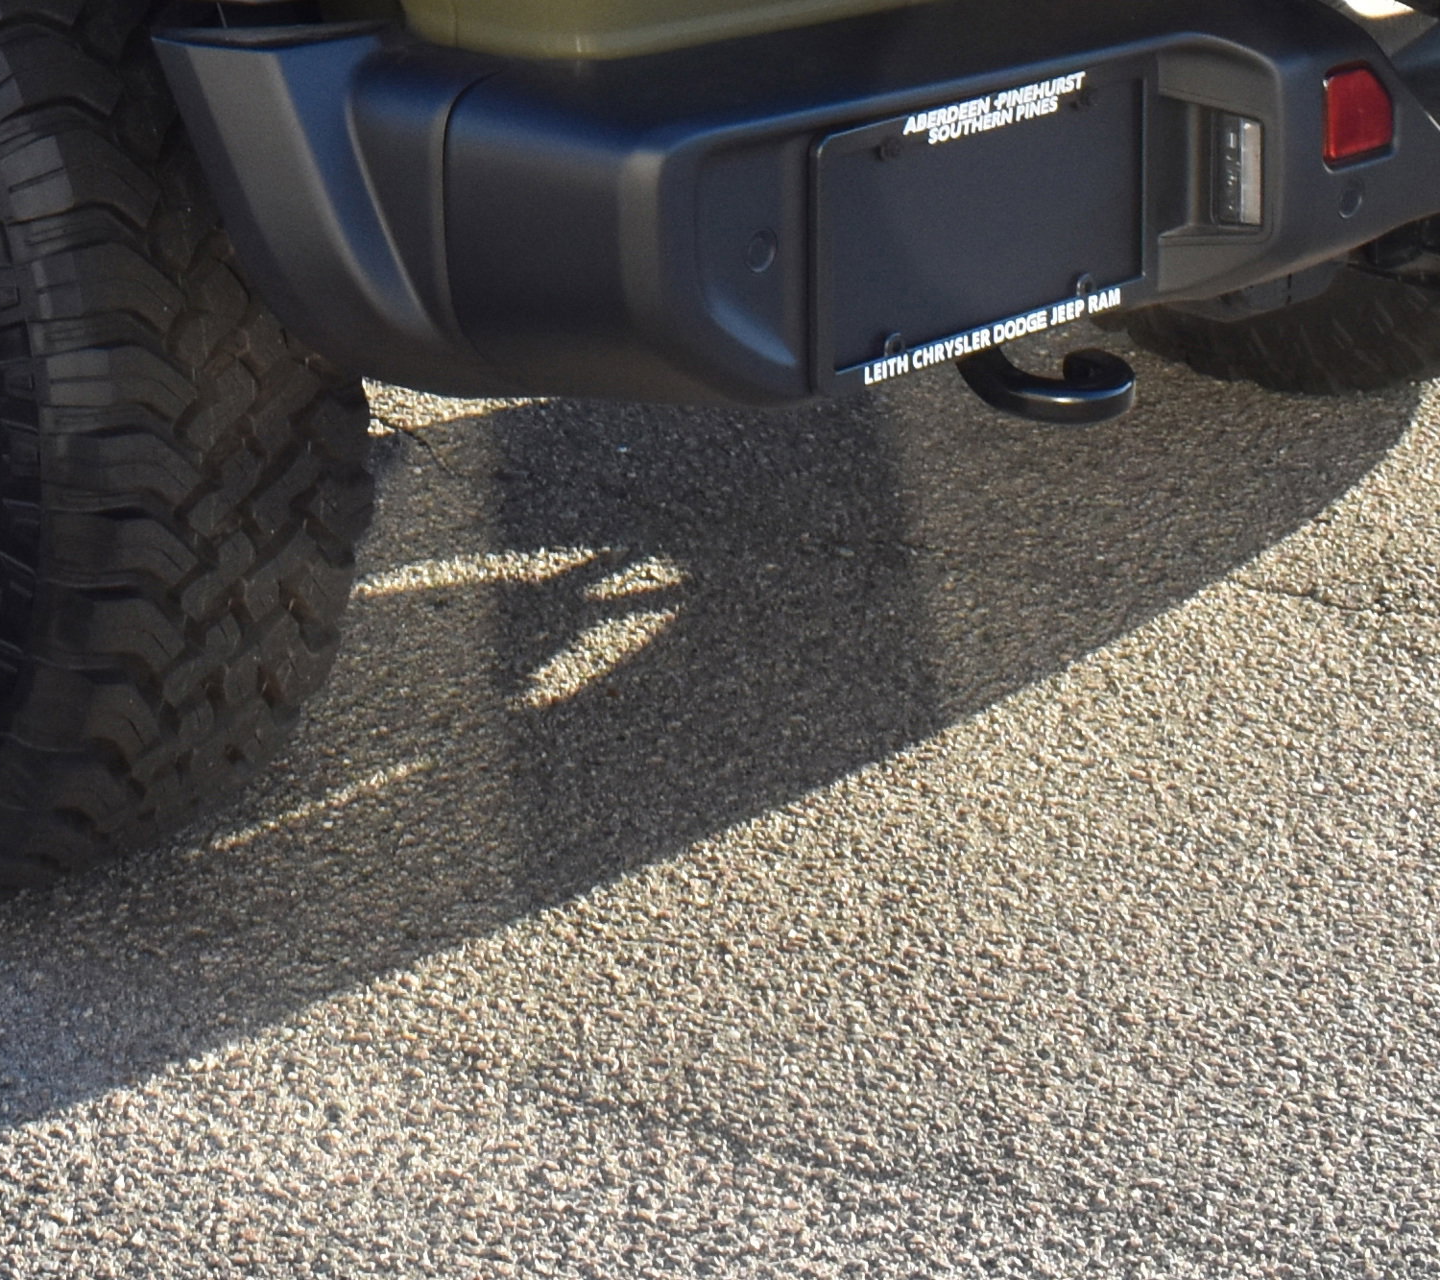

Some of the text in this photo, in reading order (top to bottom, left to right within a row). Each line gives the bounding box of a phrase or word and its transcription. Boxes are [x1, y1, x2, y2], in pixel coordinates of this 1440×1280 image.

[903, 96, 990, 135] ABERDEEN
[928, 96, 1059, 144] SOUTHERN PINES
[864, 288, 1121, 385] LEITH CHRYSLER DODGE JEEP RAM
